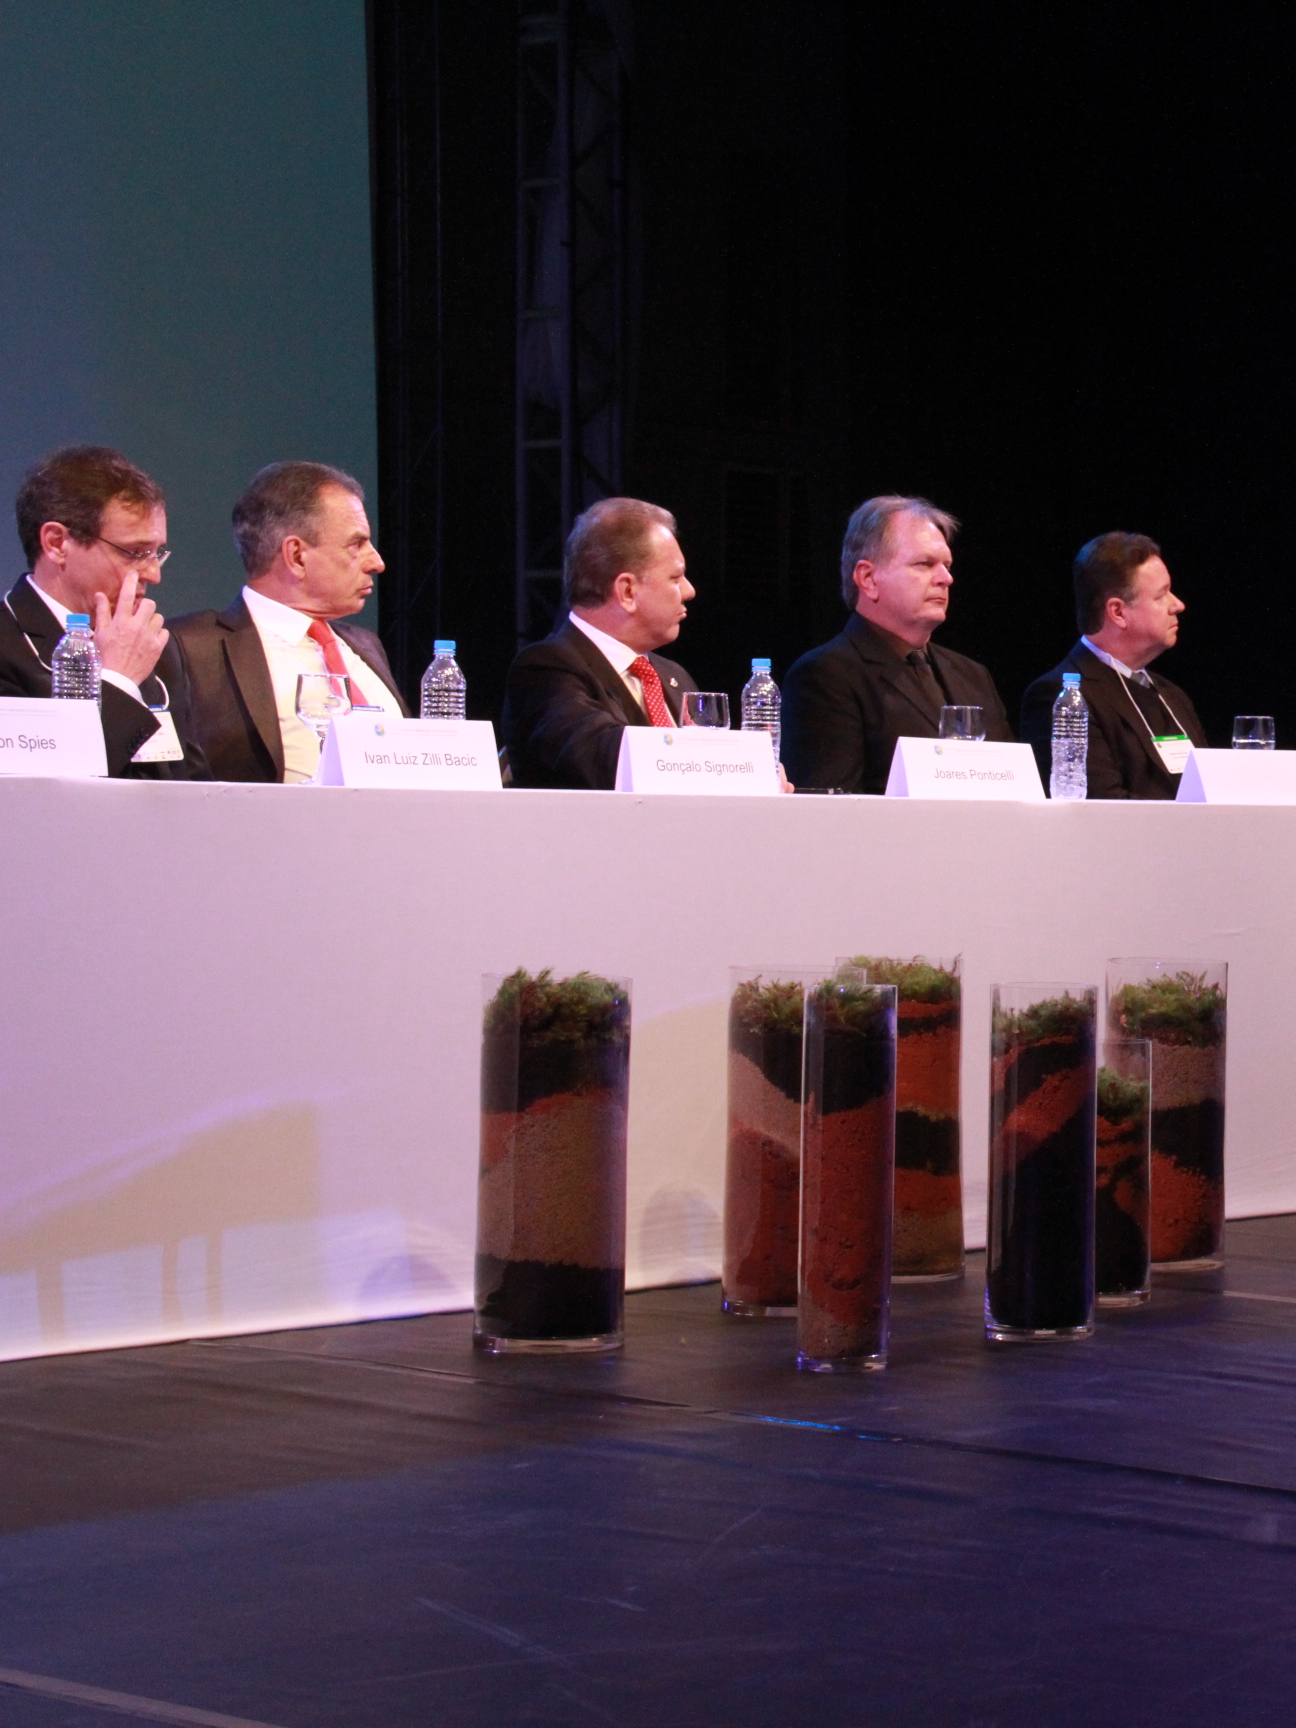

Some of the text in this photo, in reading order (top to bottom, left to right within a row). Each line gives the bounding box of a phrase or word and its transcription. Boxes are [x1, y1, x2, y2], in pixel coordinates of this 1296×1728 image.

[18, 734, 57, 752] Spies
[364, 751, 478, 767] Ivan Luiz Zilli Bacic
[656, 759, 754, 776] Gonçalo Signorelli
[934, 768, 1015, 781] Joares Ponticelli
